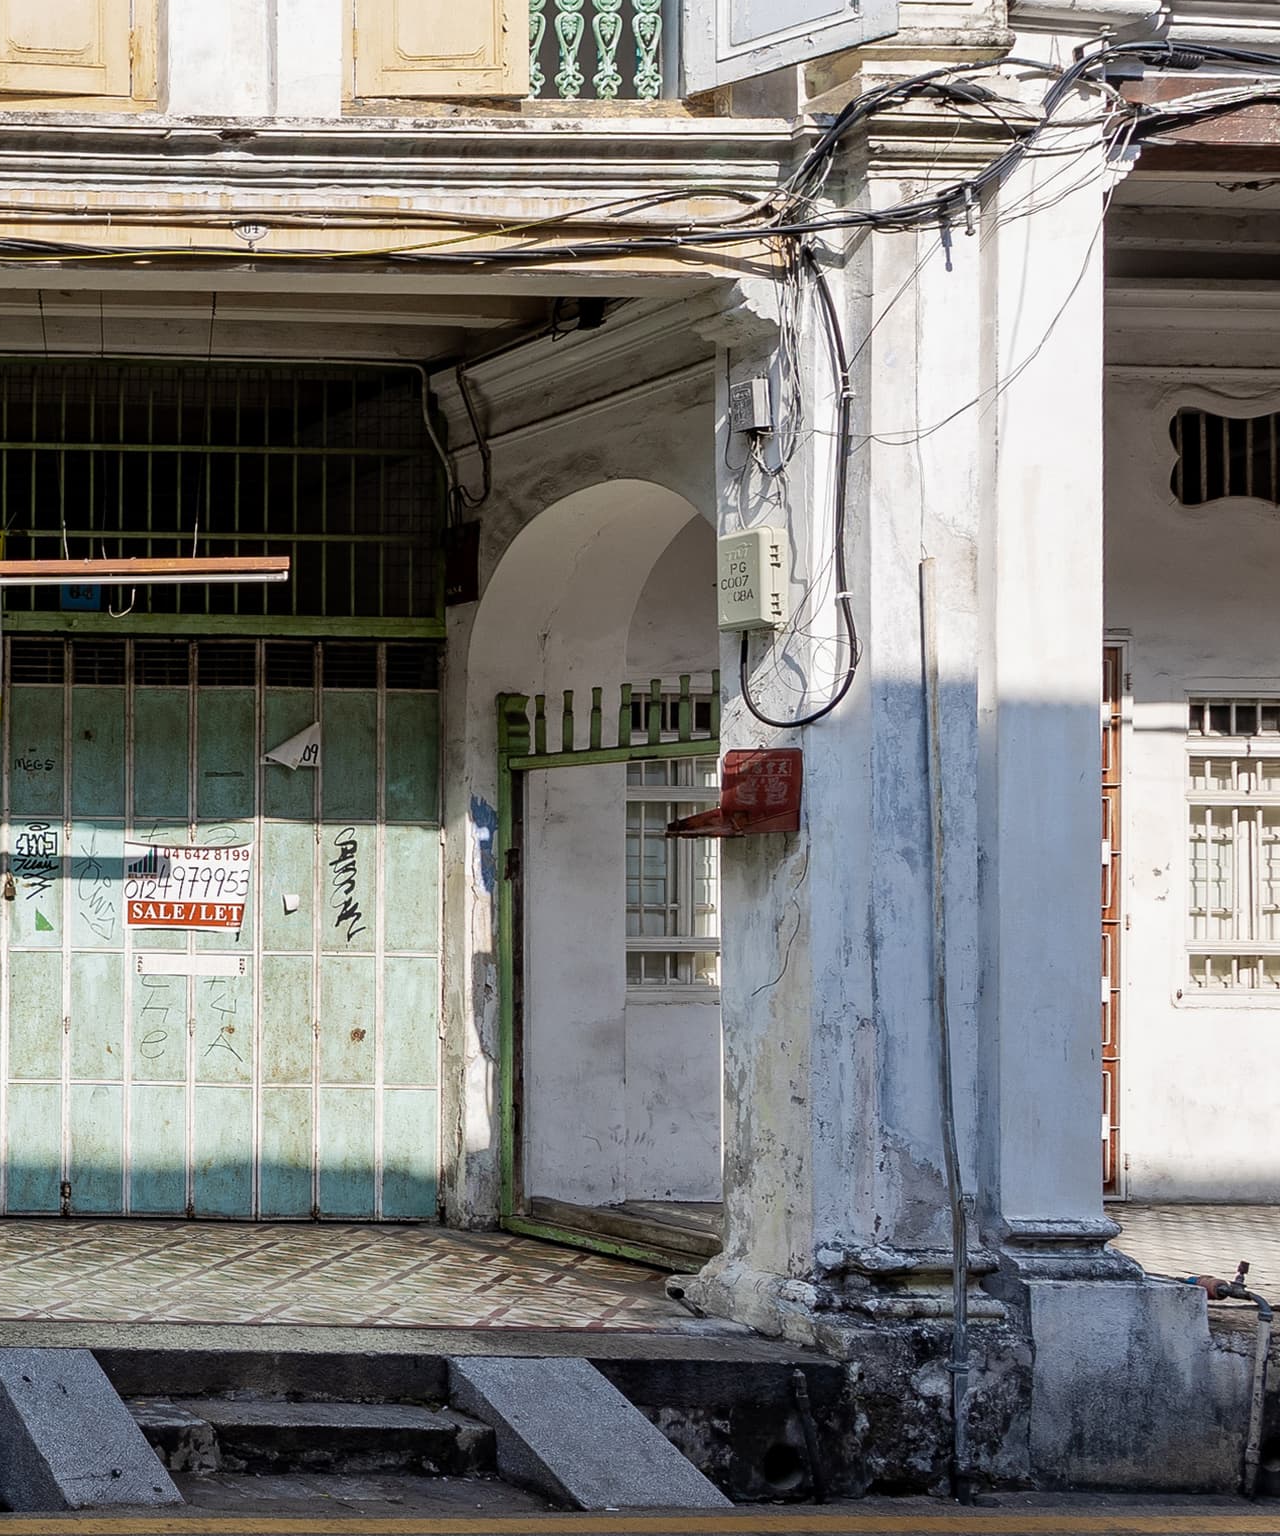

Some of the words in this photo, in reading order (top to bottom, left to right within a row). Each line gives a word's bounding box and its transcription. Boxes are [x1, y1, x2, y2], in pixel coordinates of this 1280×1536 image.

[730, 561, 747, 575] PG
[163, 847, 180, 860] 04
[184, 848, 210, 861] 642
[214, 848, 250, 862] 8199
[132, 903, 186, 920] SALE
[189, 904, 197, 921] /
[200, 905, 243, 922] LET
